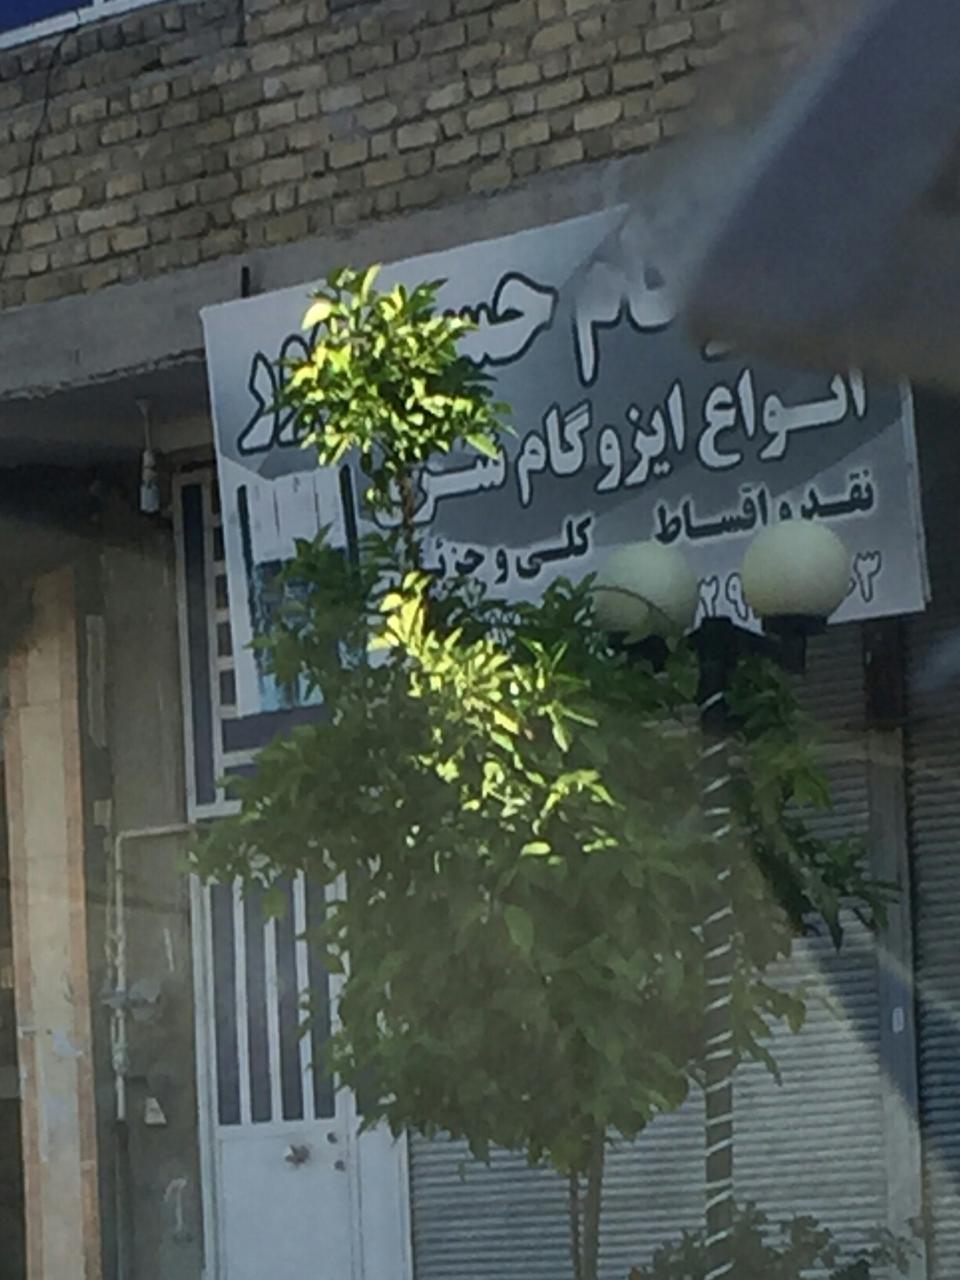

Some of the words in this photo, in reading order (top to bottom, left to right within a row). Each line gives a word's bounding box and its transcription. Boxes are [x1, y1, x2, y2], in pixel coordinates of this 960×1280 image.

[696, 362, 868, 474] انواع
[655, 487, 769, 545] اقساط
[801, 469, 875, 518] نقد
[495, 549, 510, 584] و
[516, 516, 592, 578] کلی
